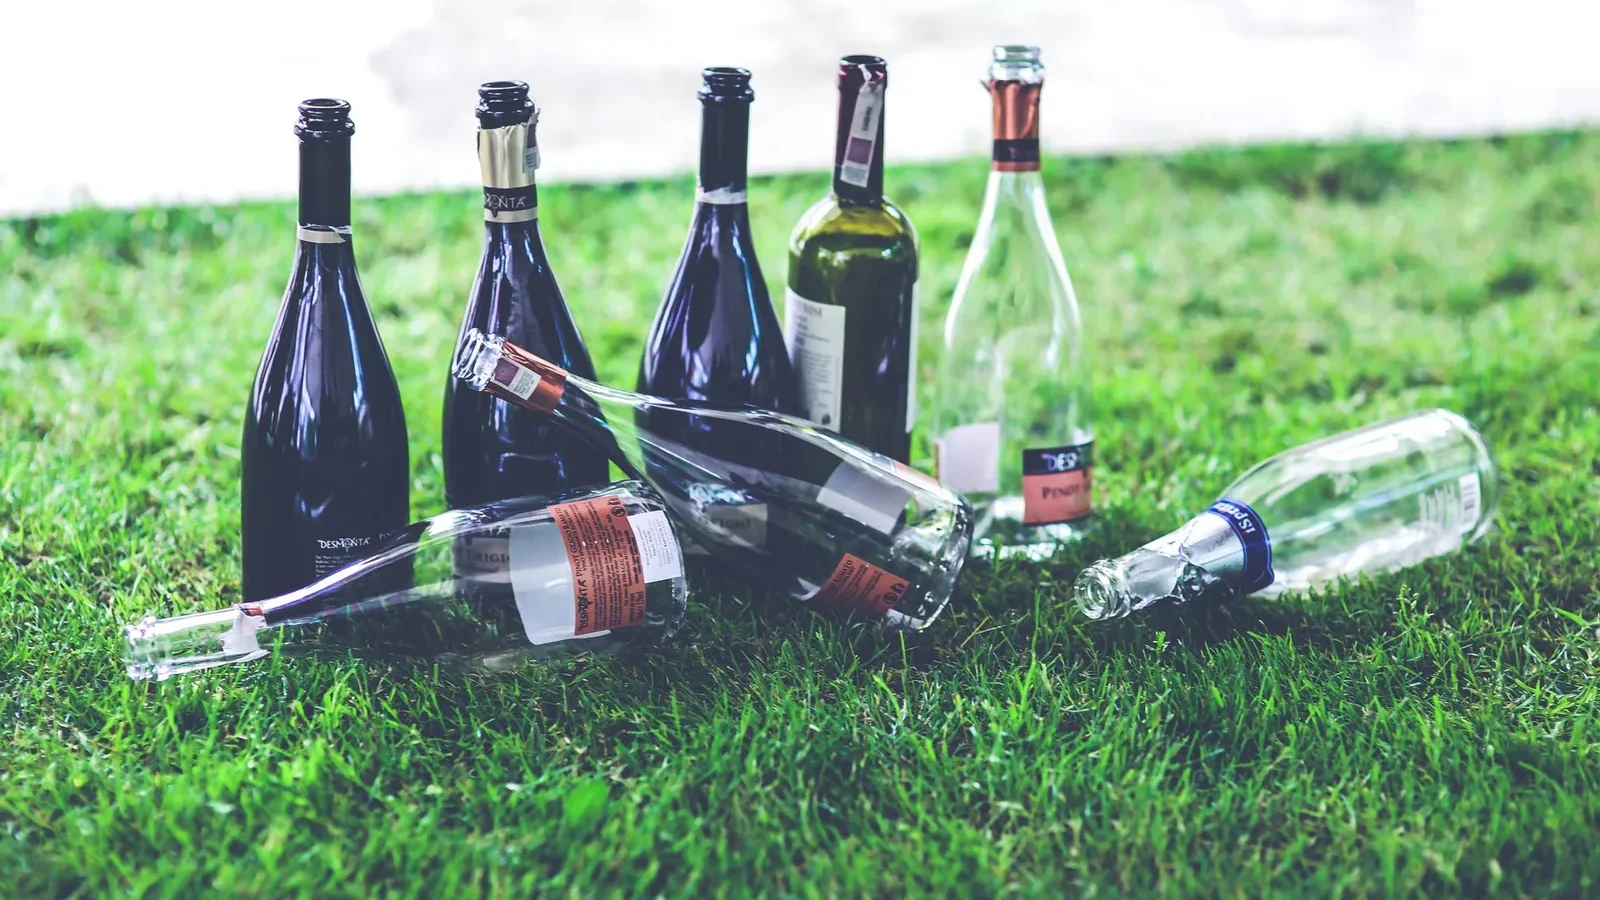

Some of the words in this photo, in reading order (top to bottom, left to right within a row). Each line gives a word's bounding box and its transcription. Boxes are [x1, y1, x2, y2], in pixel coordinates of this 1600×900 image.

[317, 537, 371, 551] DESMONTA
[572, 554, 583, 577] PINOT
[578, 579, 593, 631] DESMONTA
